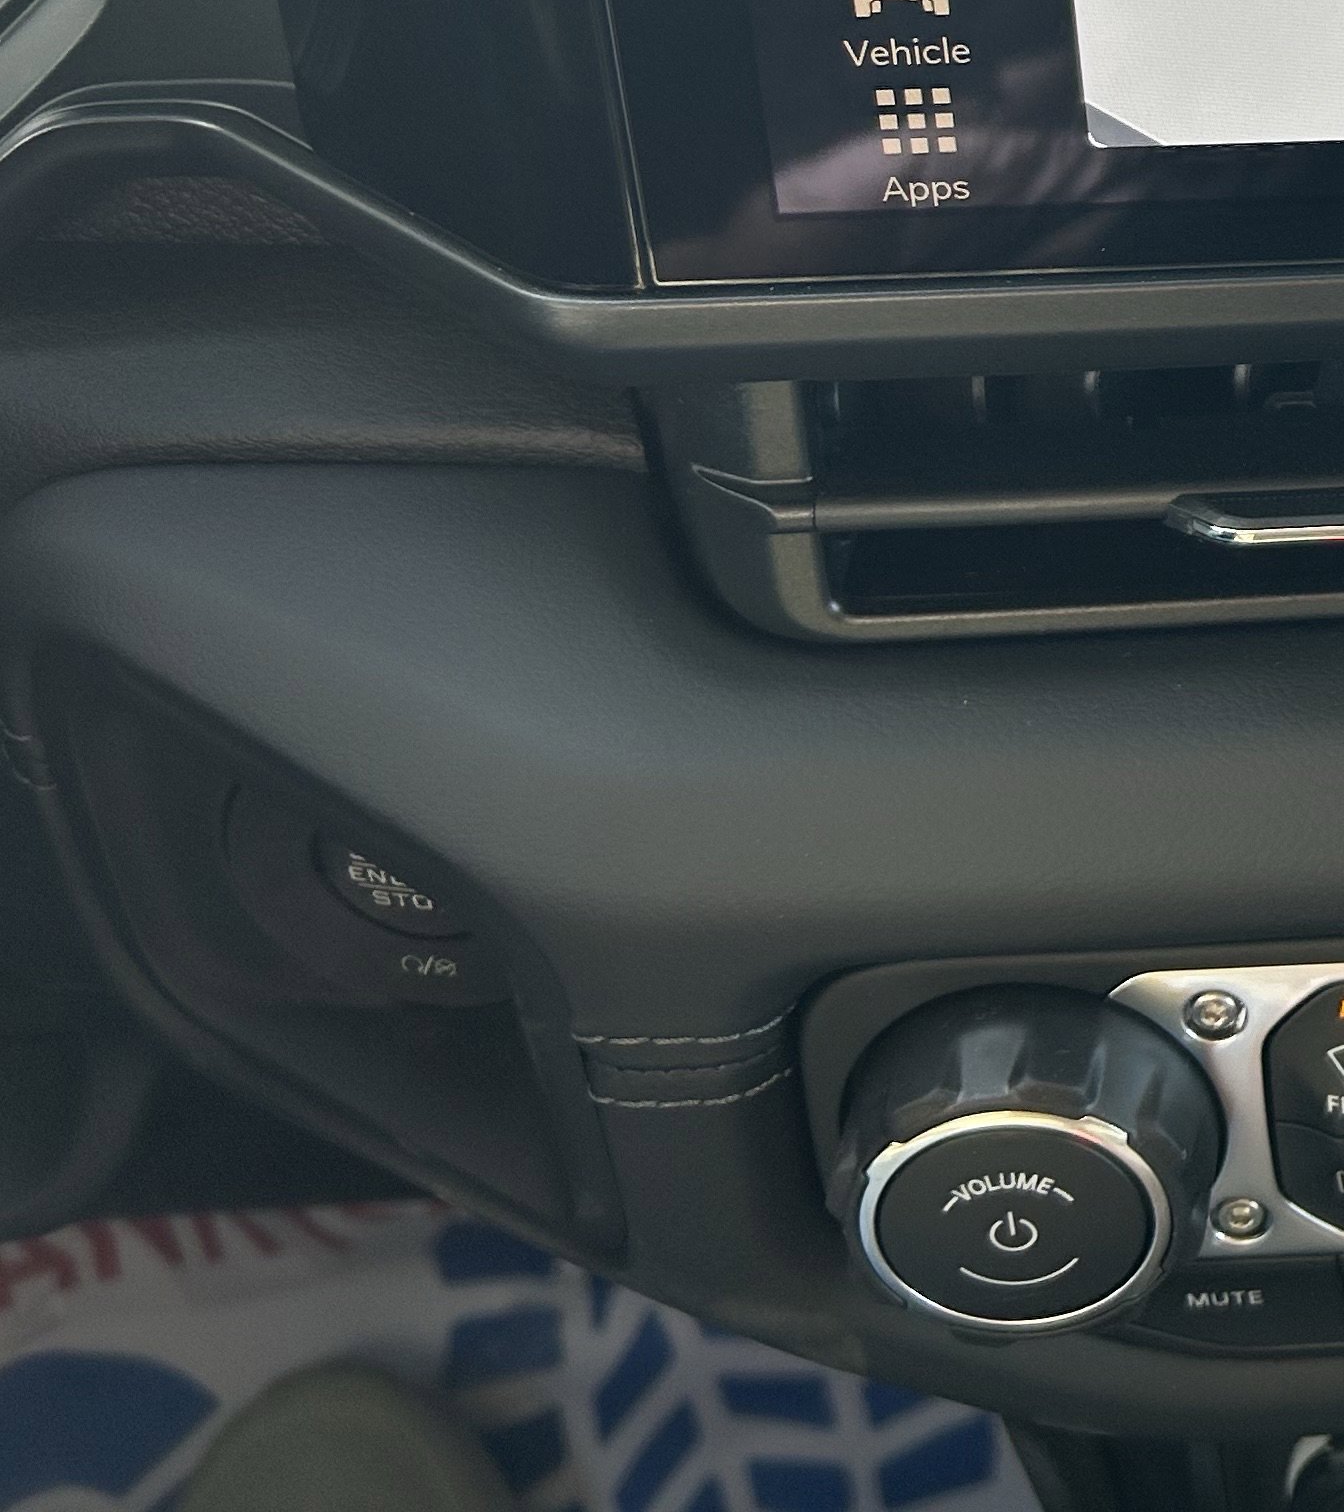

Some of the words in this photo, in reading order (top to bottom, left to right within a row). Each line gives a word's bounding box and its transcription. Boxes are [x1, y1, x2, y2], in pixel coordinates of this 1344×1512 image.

[843, 38, 971, 67] Vehicle
[882, 176, 970, 207] Apps
[952, 1172, 1055, 1202] VOLUME
[1186, 1289, 1264, 1309] MUTE
